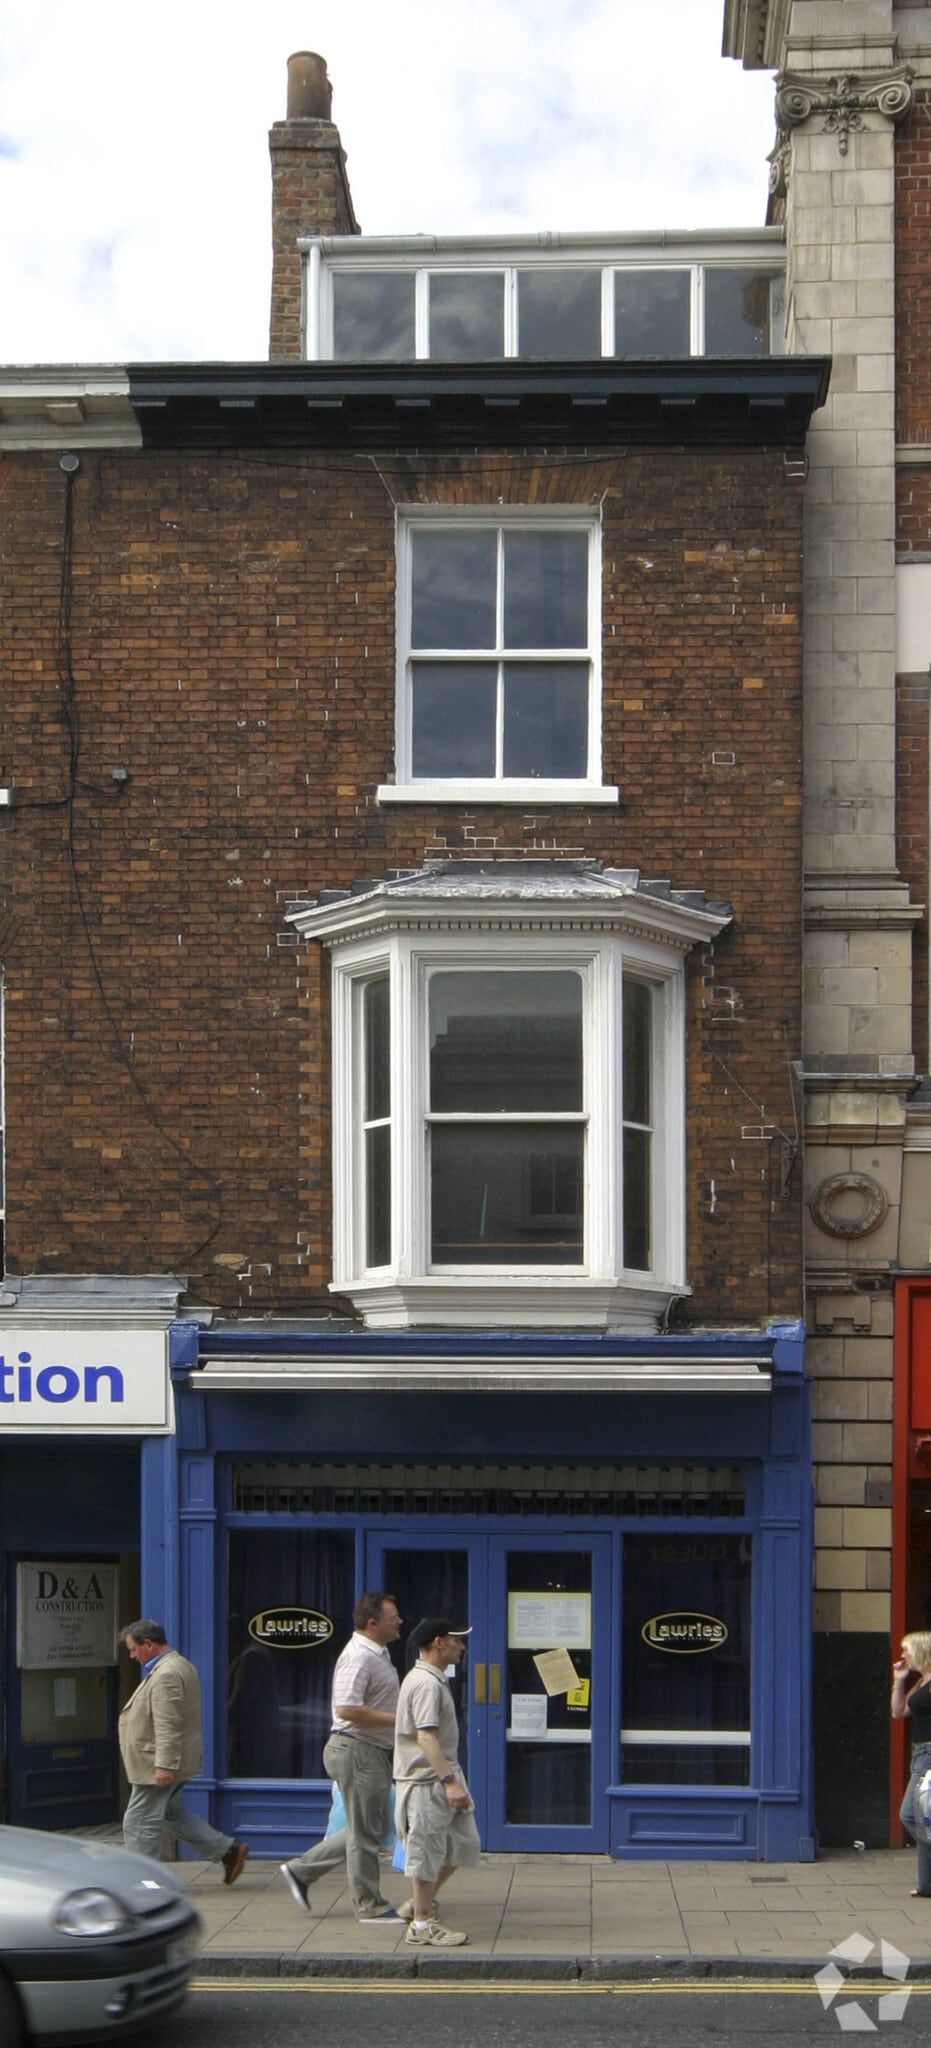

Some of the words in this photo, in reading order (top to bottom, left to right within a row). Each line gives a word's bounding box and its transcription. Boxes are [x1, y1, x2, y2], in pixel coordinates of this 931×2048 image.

[38, 1571, 58, 1599] D
[61, 1578, 79, 1599] &
[84, 1573, 104, 1599] A
[35, 1601, 104, 1612] CONSTRUCTION
[256, 1615, 328, 1636] Lawries
[650, 1619, 722, 1640] Lawries
